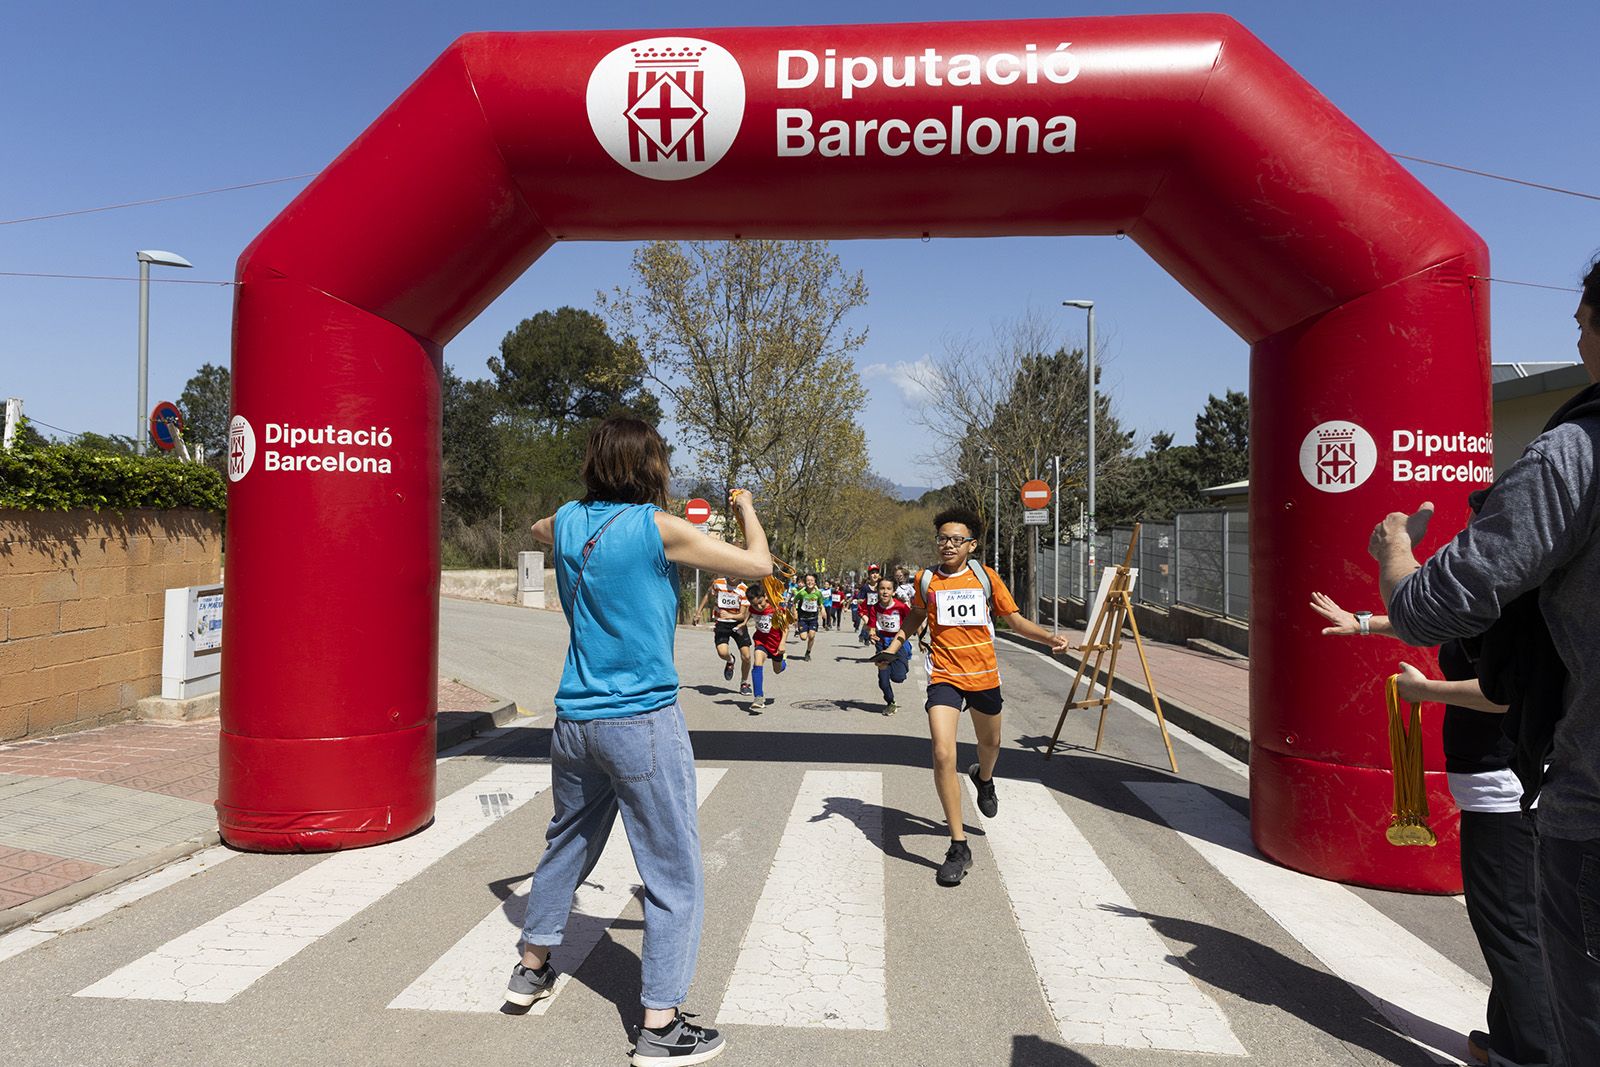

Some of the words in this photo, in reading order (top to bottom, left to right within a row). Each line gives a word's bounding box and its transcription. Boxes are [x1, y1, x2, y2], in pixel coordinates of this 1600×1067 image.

[776, 42, 1081, 100] Diputació
[776, 105, 1077, 158] Barcelona
[265, 423, 393, 448] Diputació
[1393, 430, 1493, 457] Diputació
[264, 451, 392, 474] Barcelona
[1393, 460, 1493, 483] Barcelona
[721, 598, 736, 606] 056
[947, 604, 976, 617] 101
[880, 621, 895, 629] 125
